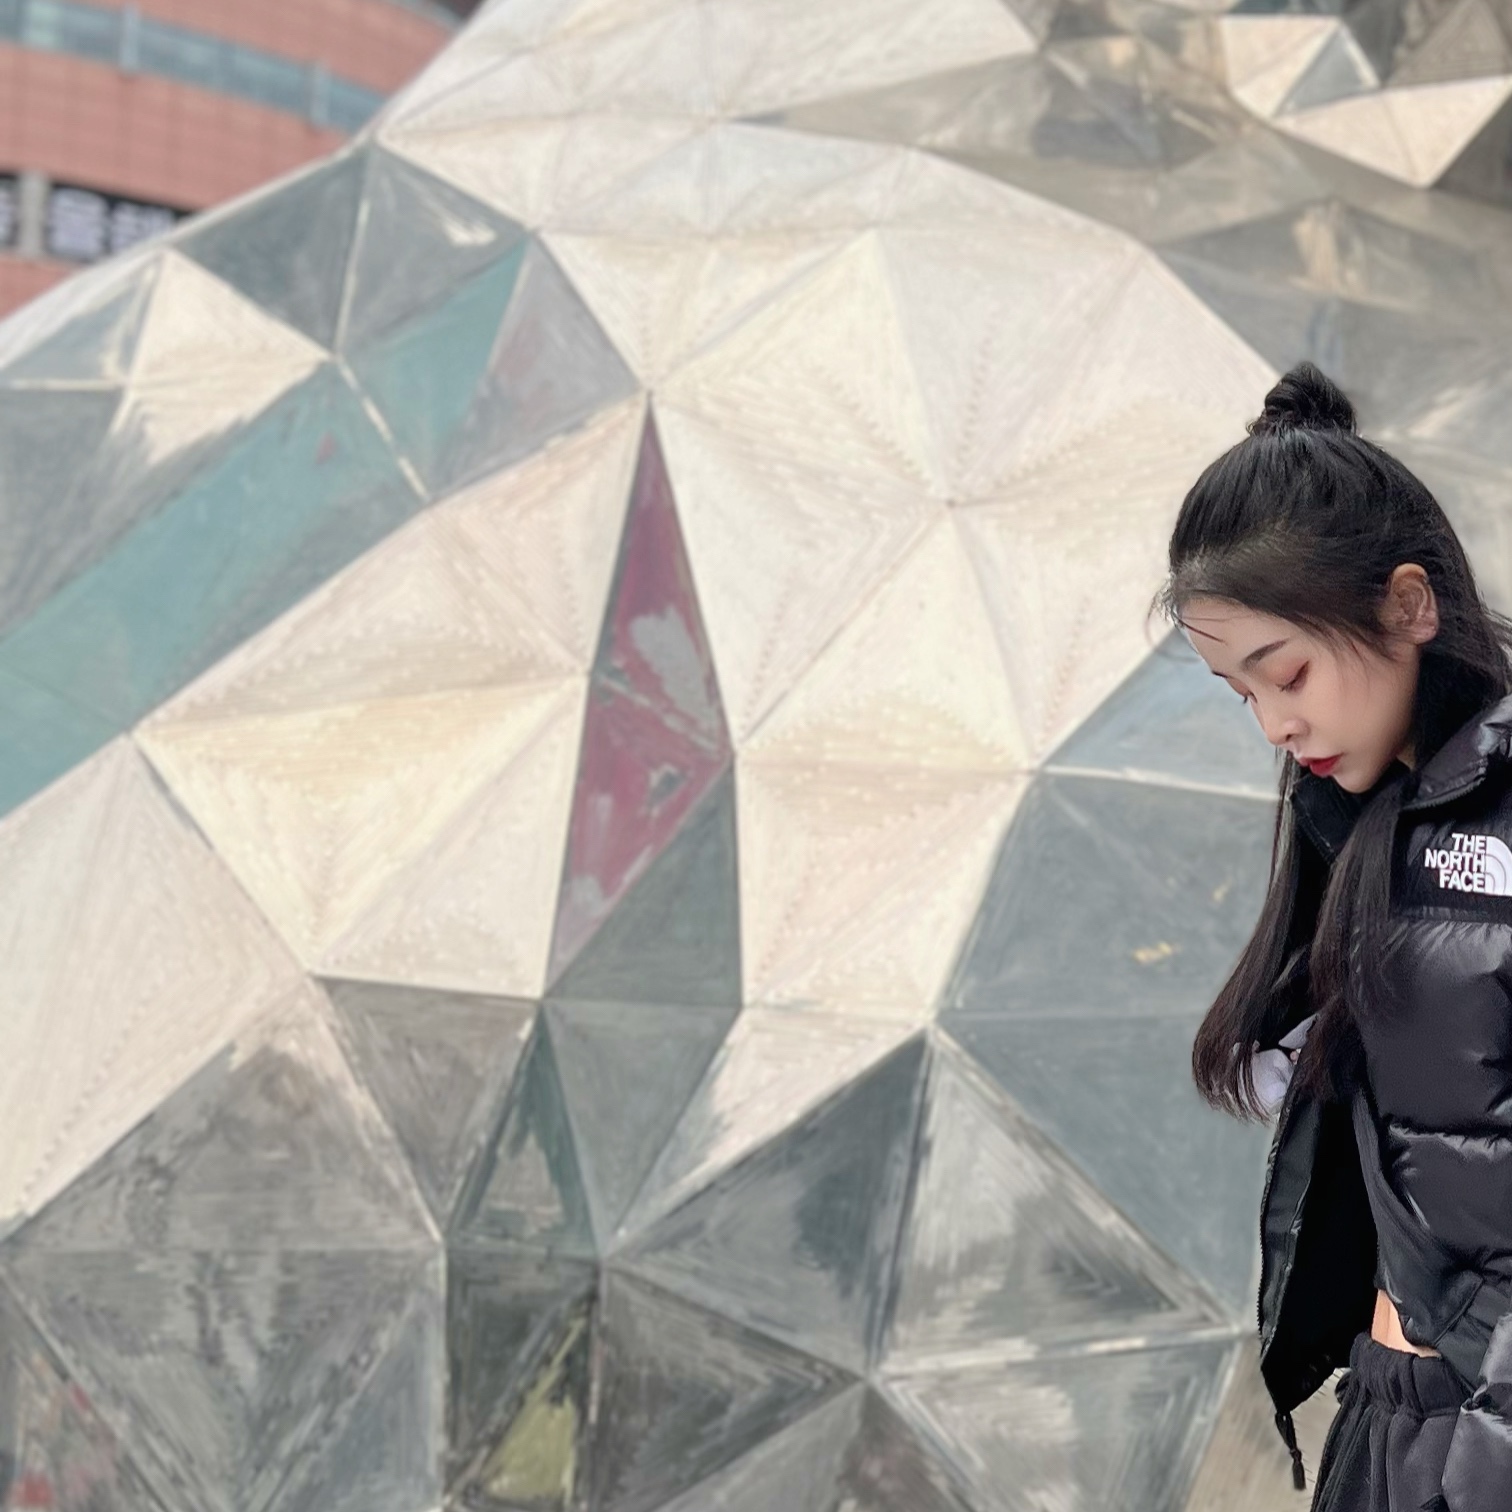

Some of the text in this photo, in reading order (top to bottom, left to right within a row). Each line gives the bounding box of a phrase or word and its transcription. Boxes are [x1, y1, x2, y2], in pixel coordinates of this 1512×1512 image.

[1451, 833, 1486, 853] THE
[1424, 848, 1485, 873] NORTH
[1439, 869, 1485, 893] FACE
